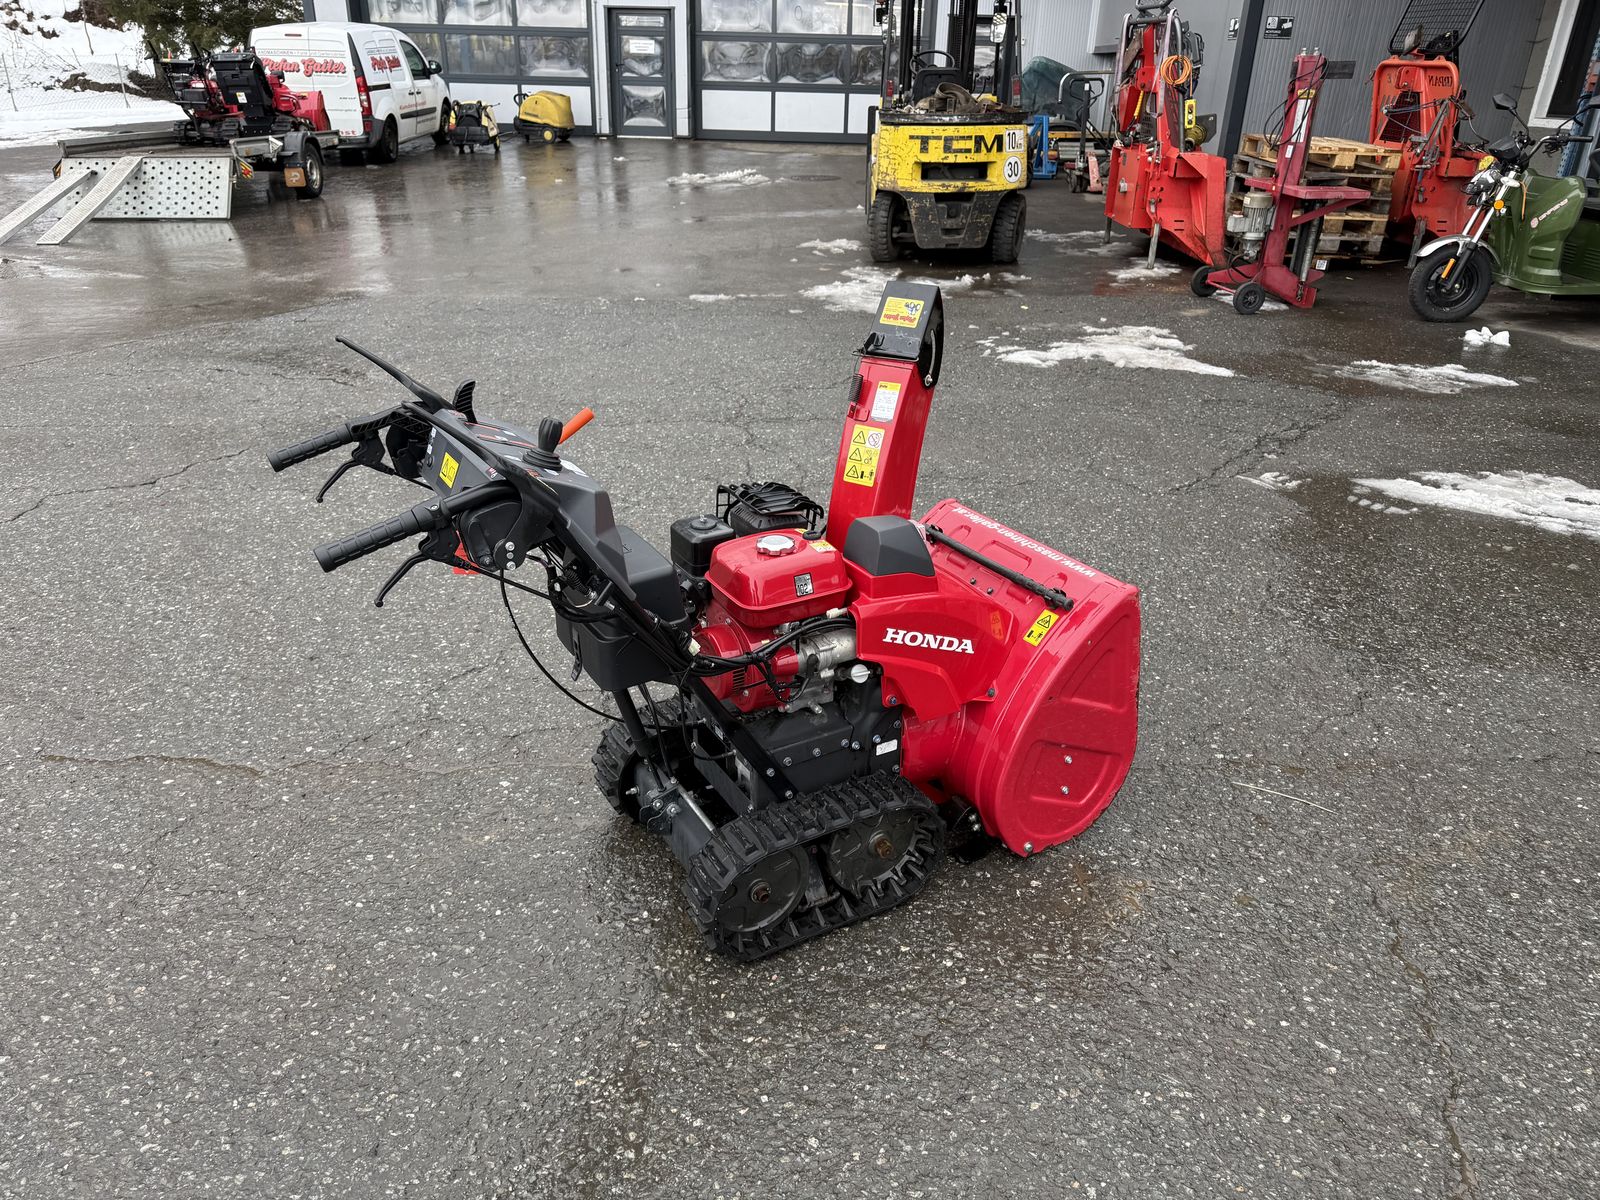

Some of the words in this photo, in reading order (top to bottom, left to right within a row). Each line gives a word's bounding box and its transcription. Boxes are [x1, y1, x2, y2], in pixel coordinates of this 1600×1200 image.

[301, 57, 346, 77] Gailer
[908, 134, 1004, 154] TCM
[1007, 132, 1016, 149] 10
[1007, 161, 1019, 178] 30
[952, 506, 1097, 578] www.maschinen-gailer.at
[882, 627, 975, 654] HONDA
